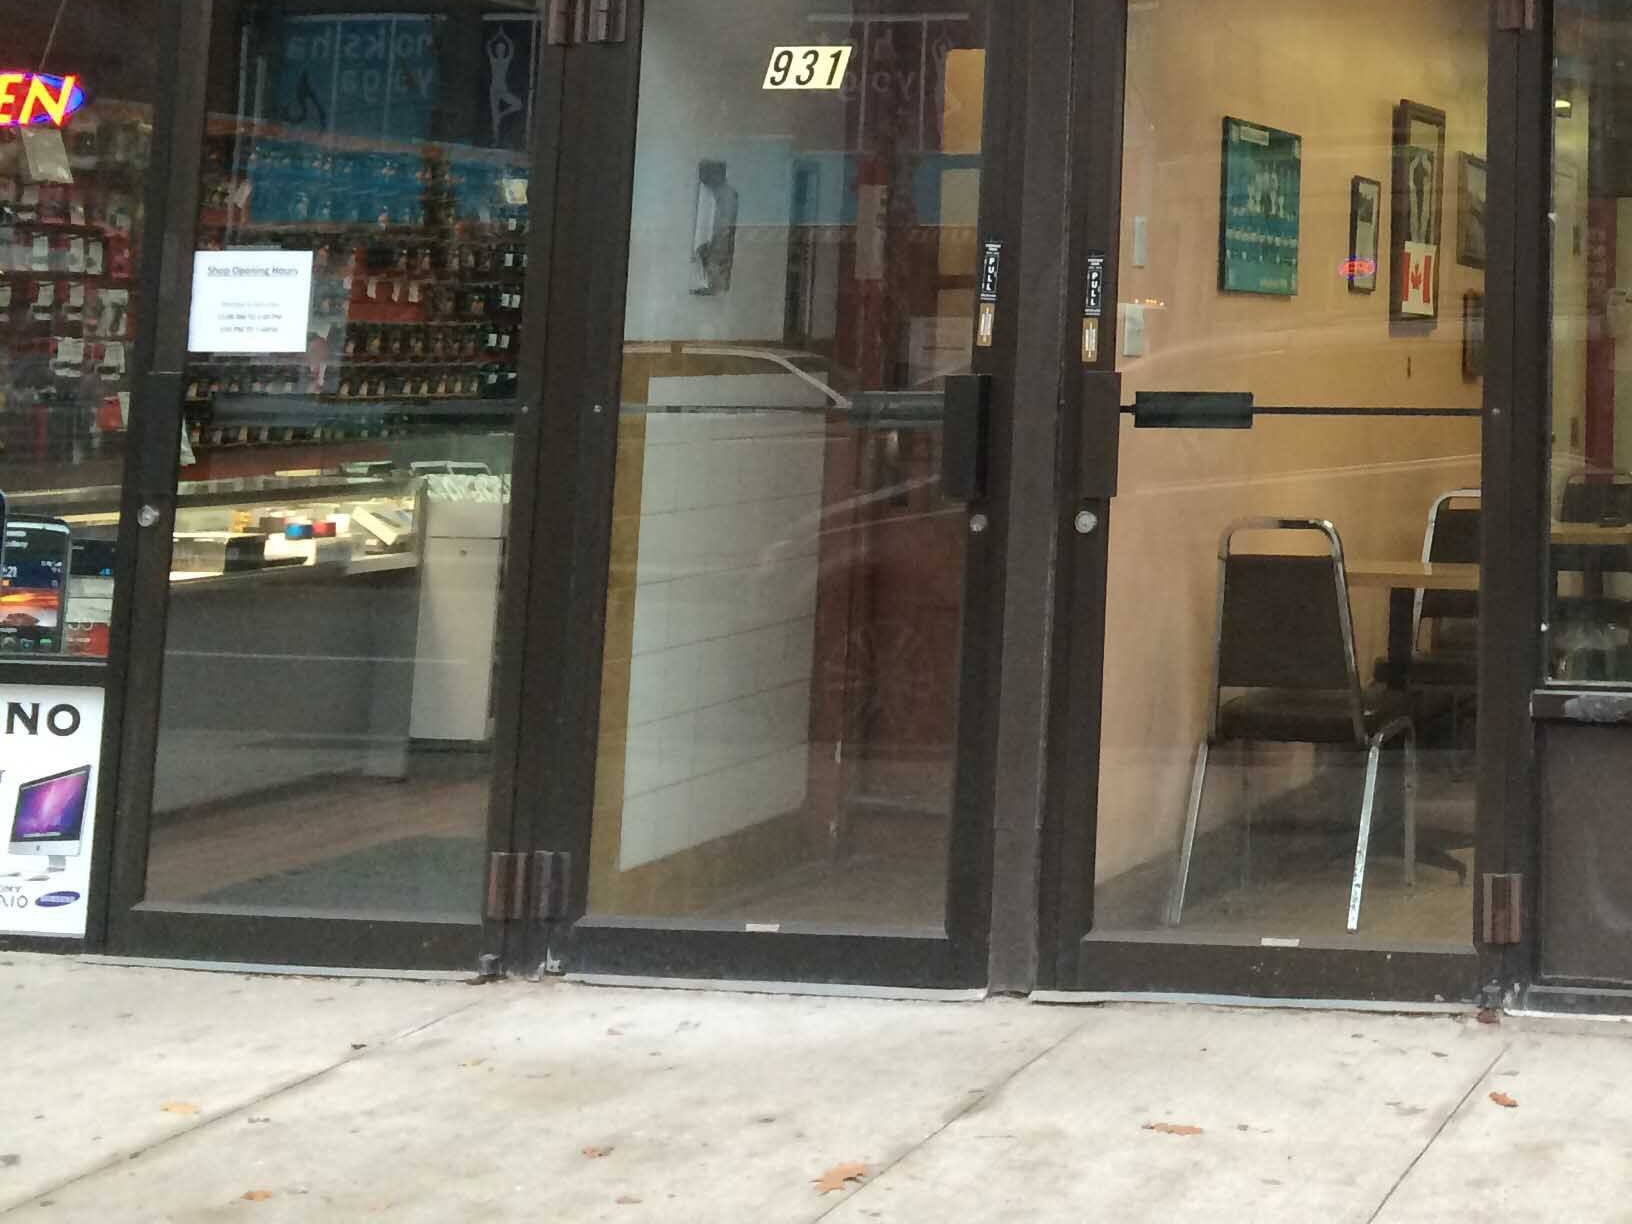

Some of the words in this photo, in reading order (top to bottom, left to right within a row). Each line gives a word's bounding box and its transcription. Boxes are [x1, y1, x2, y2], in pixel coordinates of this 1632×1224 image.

[769, 49, 843, 87] 931
[232, 266, 270, 277] Opening
[985, 256, 996, 291] PULL
[1089, 271, 1099, 307] PULL
